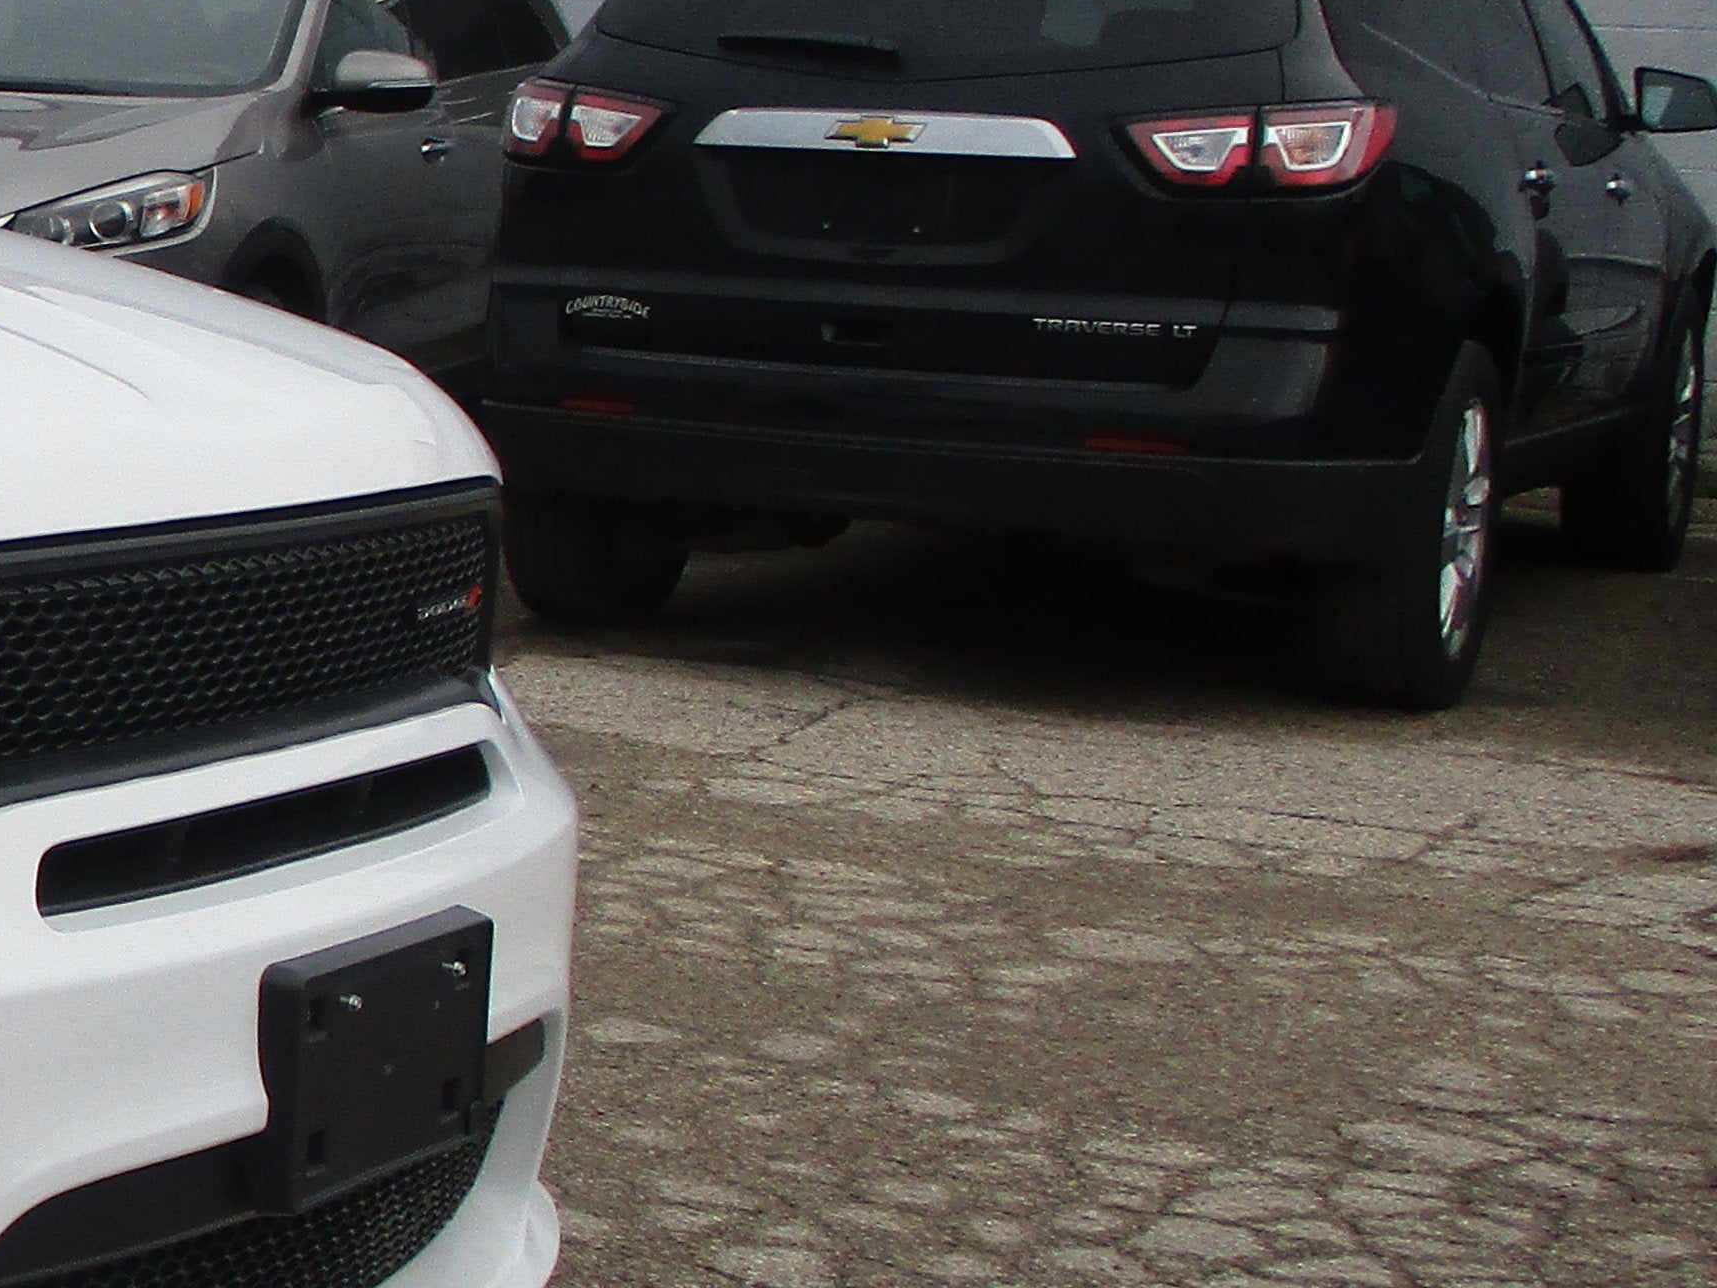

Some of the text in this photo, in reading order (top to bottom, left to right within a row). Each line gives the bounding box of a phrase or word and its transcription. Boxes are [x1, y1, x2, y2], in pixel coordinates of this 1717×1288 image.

[565, 294, 653, 319] COUNTRYSIDE
[1033, 317, 1198, 339] TRAVERSE LT
